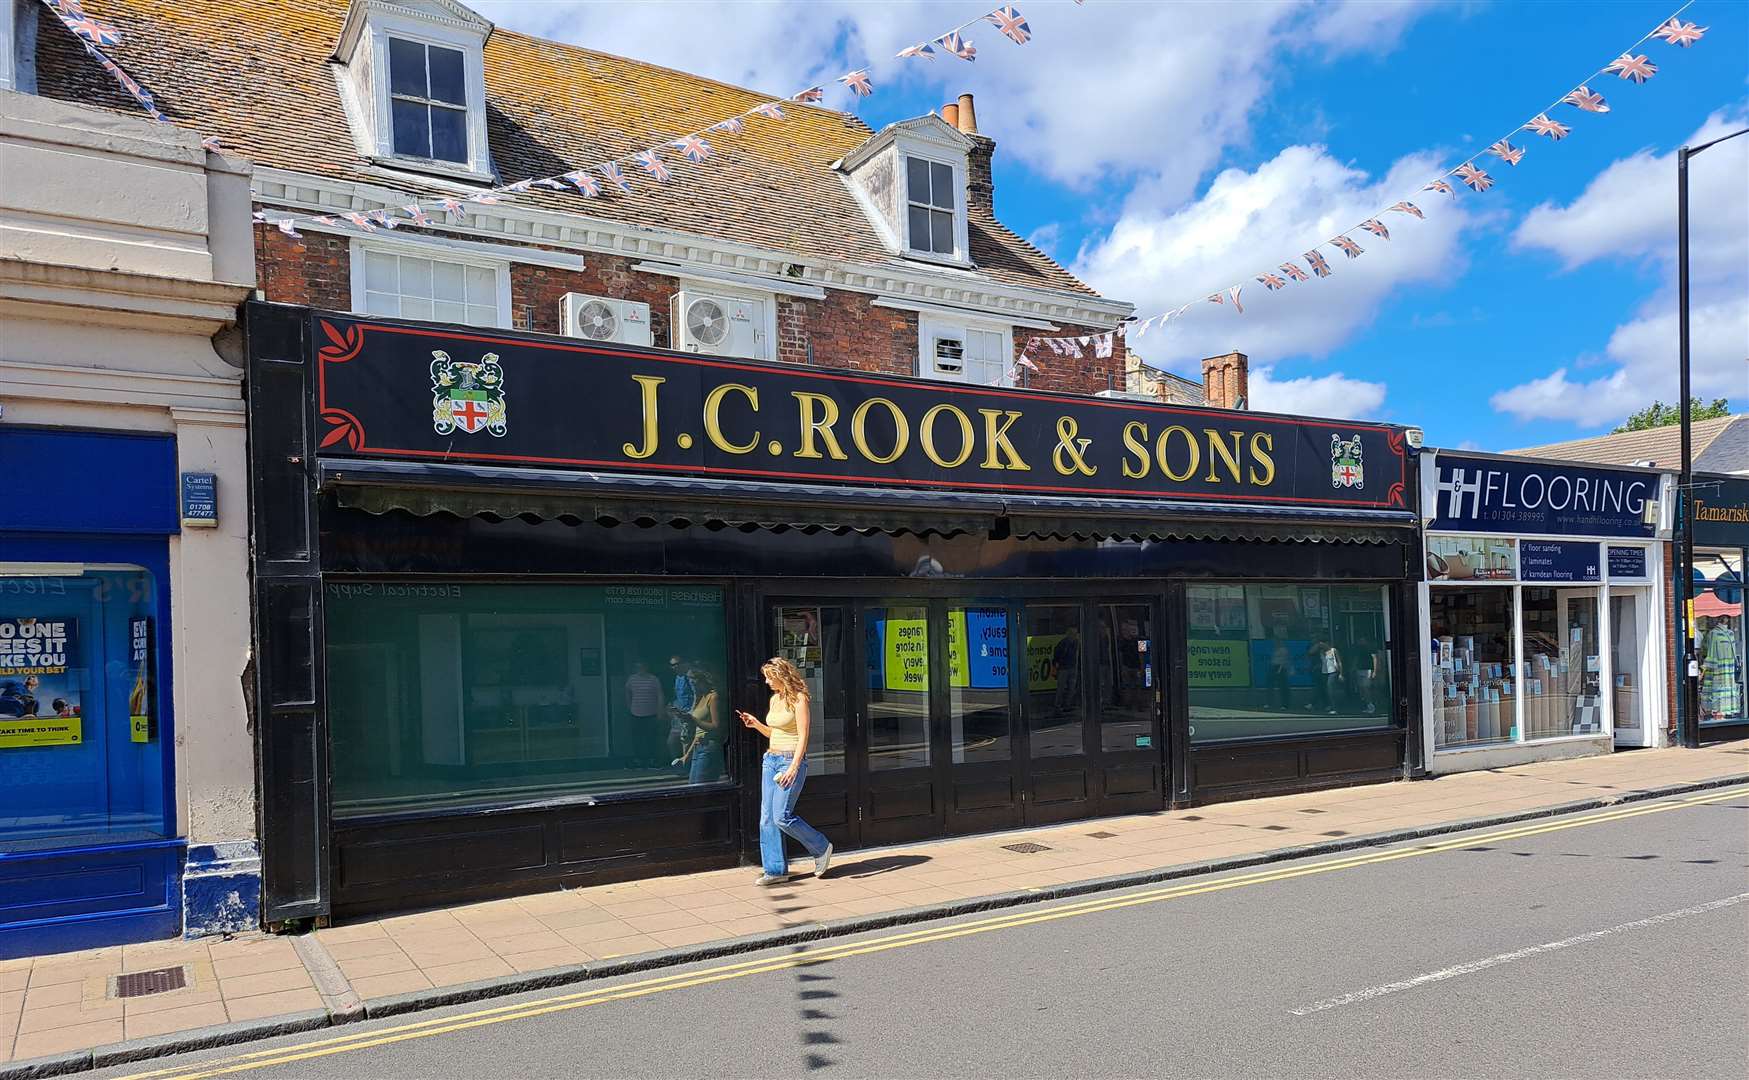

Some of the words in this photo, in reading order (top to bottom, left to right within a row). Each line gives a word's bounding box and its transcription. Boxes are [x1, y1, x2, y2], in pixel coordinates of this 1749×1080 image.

[1052, 416, 1098, 476] &
[1122, 420, 1276, 487] SONS
[186, 475, 212, 484] Cartel
[1484, 471, 1646, 515] FLOORING
[1492, 510, 1516, 521] 01304
[1517, 511, 1545, 522] 389995
[1694, 500, 1749, 522] Tamarisk
[1528, 544, 1541, 552] floor
[1542, 544, 1561, 553] sanding
[1528, 557, 1552, 565] laminates
[1529, 570, 1552, 578] karndean
[1553, 570, 1573, 580] flooring
[19, 623, 66, 638] ONE
[45, 638, 67, 653] IT
[27, 653, 66, 666] YOU
[16, 667, 45, 675] YOUR
